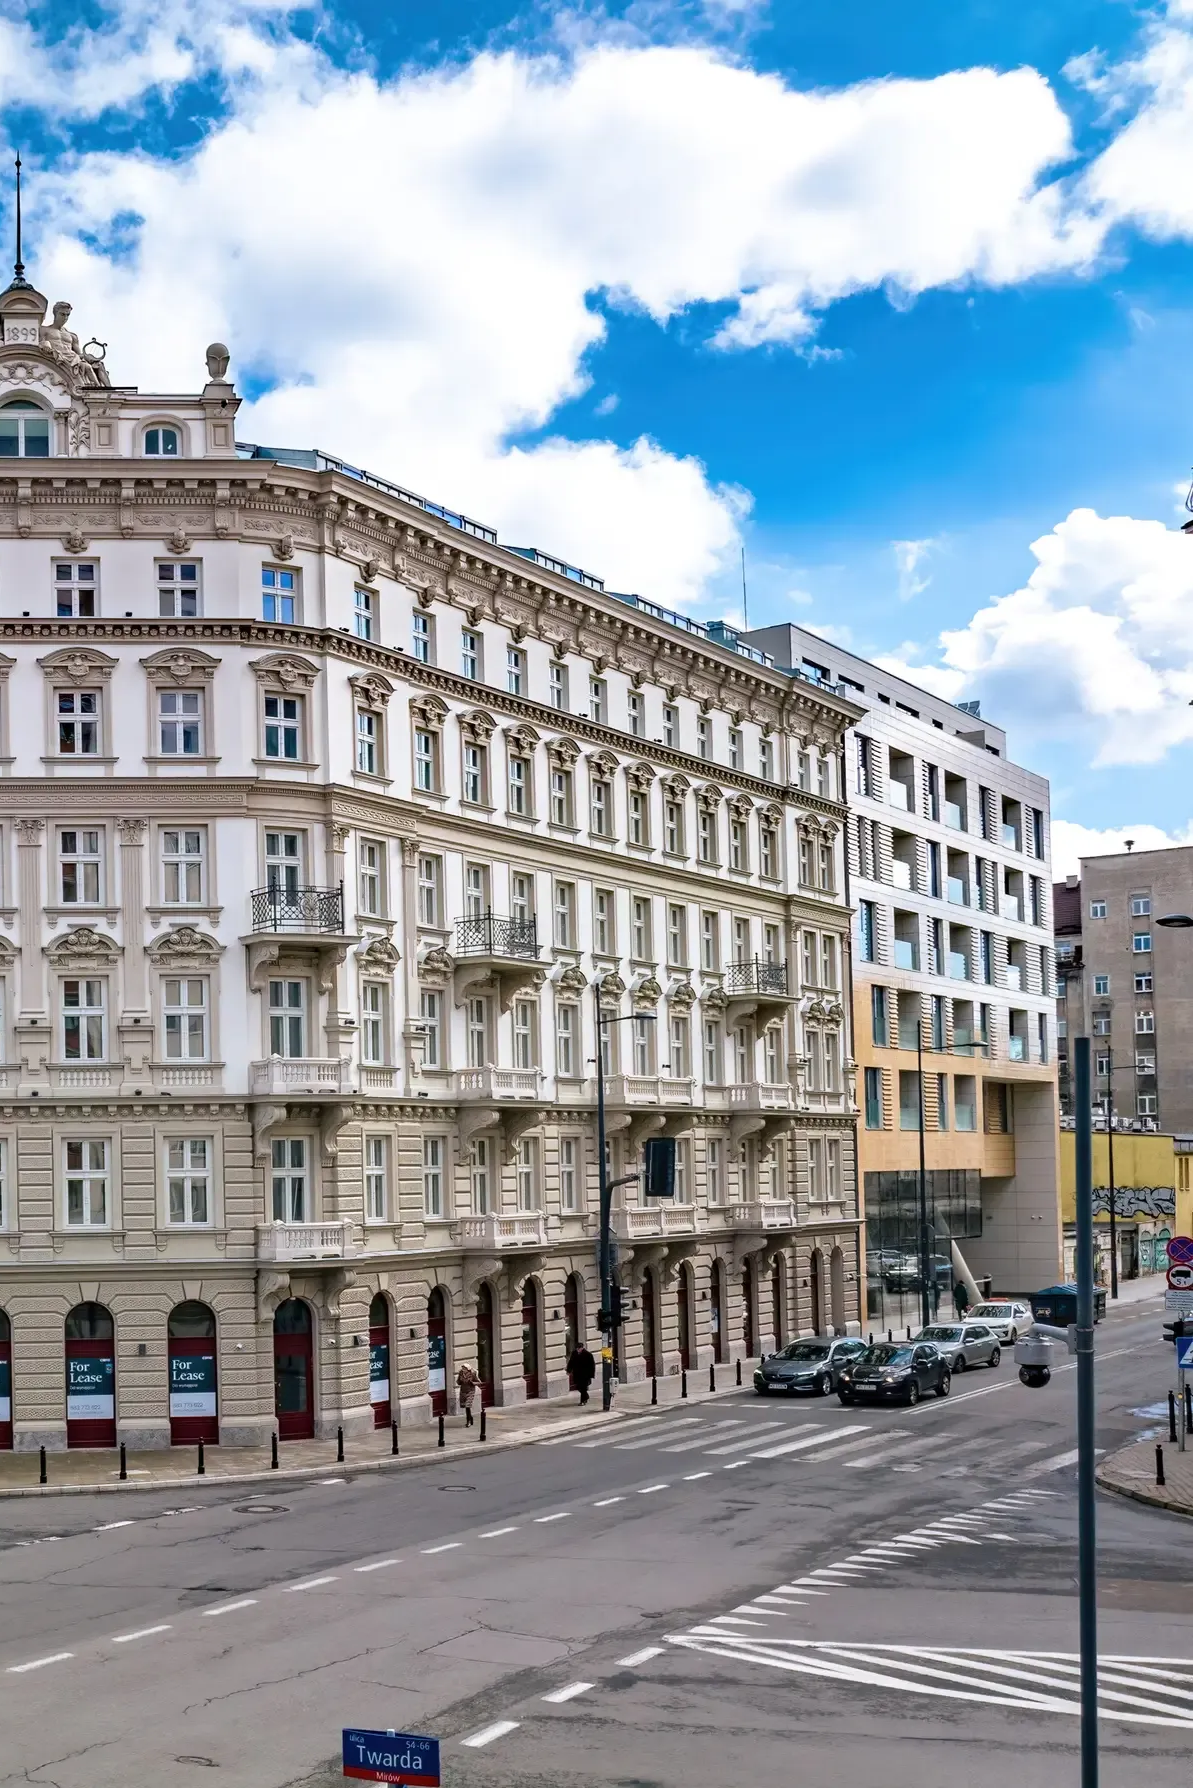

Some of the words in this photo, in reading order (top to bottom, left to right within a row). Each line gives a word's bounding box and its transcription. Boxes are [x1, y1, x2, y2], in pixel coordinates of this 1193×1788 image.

[6, 327, 37, 341] 1899
[69, 1362, 91, 1372] For
[172, 1359, 193, 1370] For
[369, 1361, 384, 1370] ease
[69, 1373, 103, 1383] Lease
[172, 1371, 205, 1381] Lease
[349, 1734, 364, 1744] ulica
[405, 1740, 430, 1751] 54-66
[356, 1745, 423, 1770] Twarda
[376, 1771, 400, 1783] Mirów
